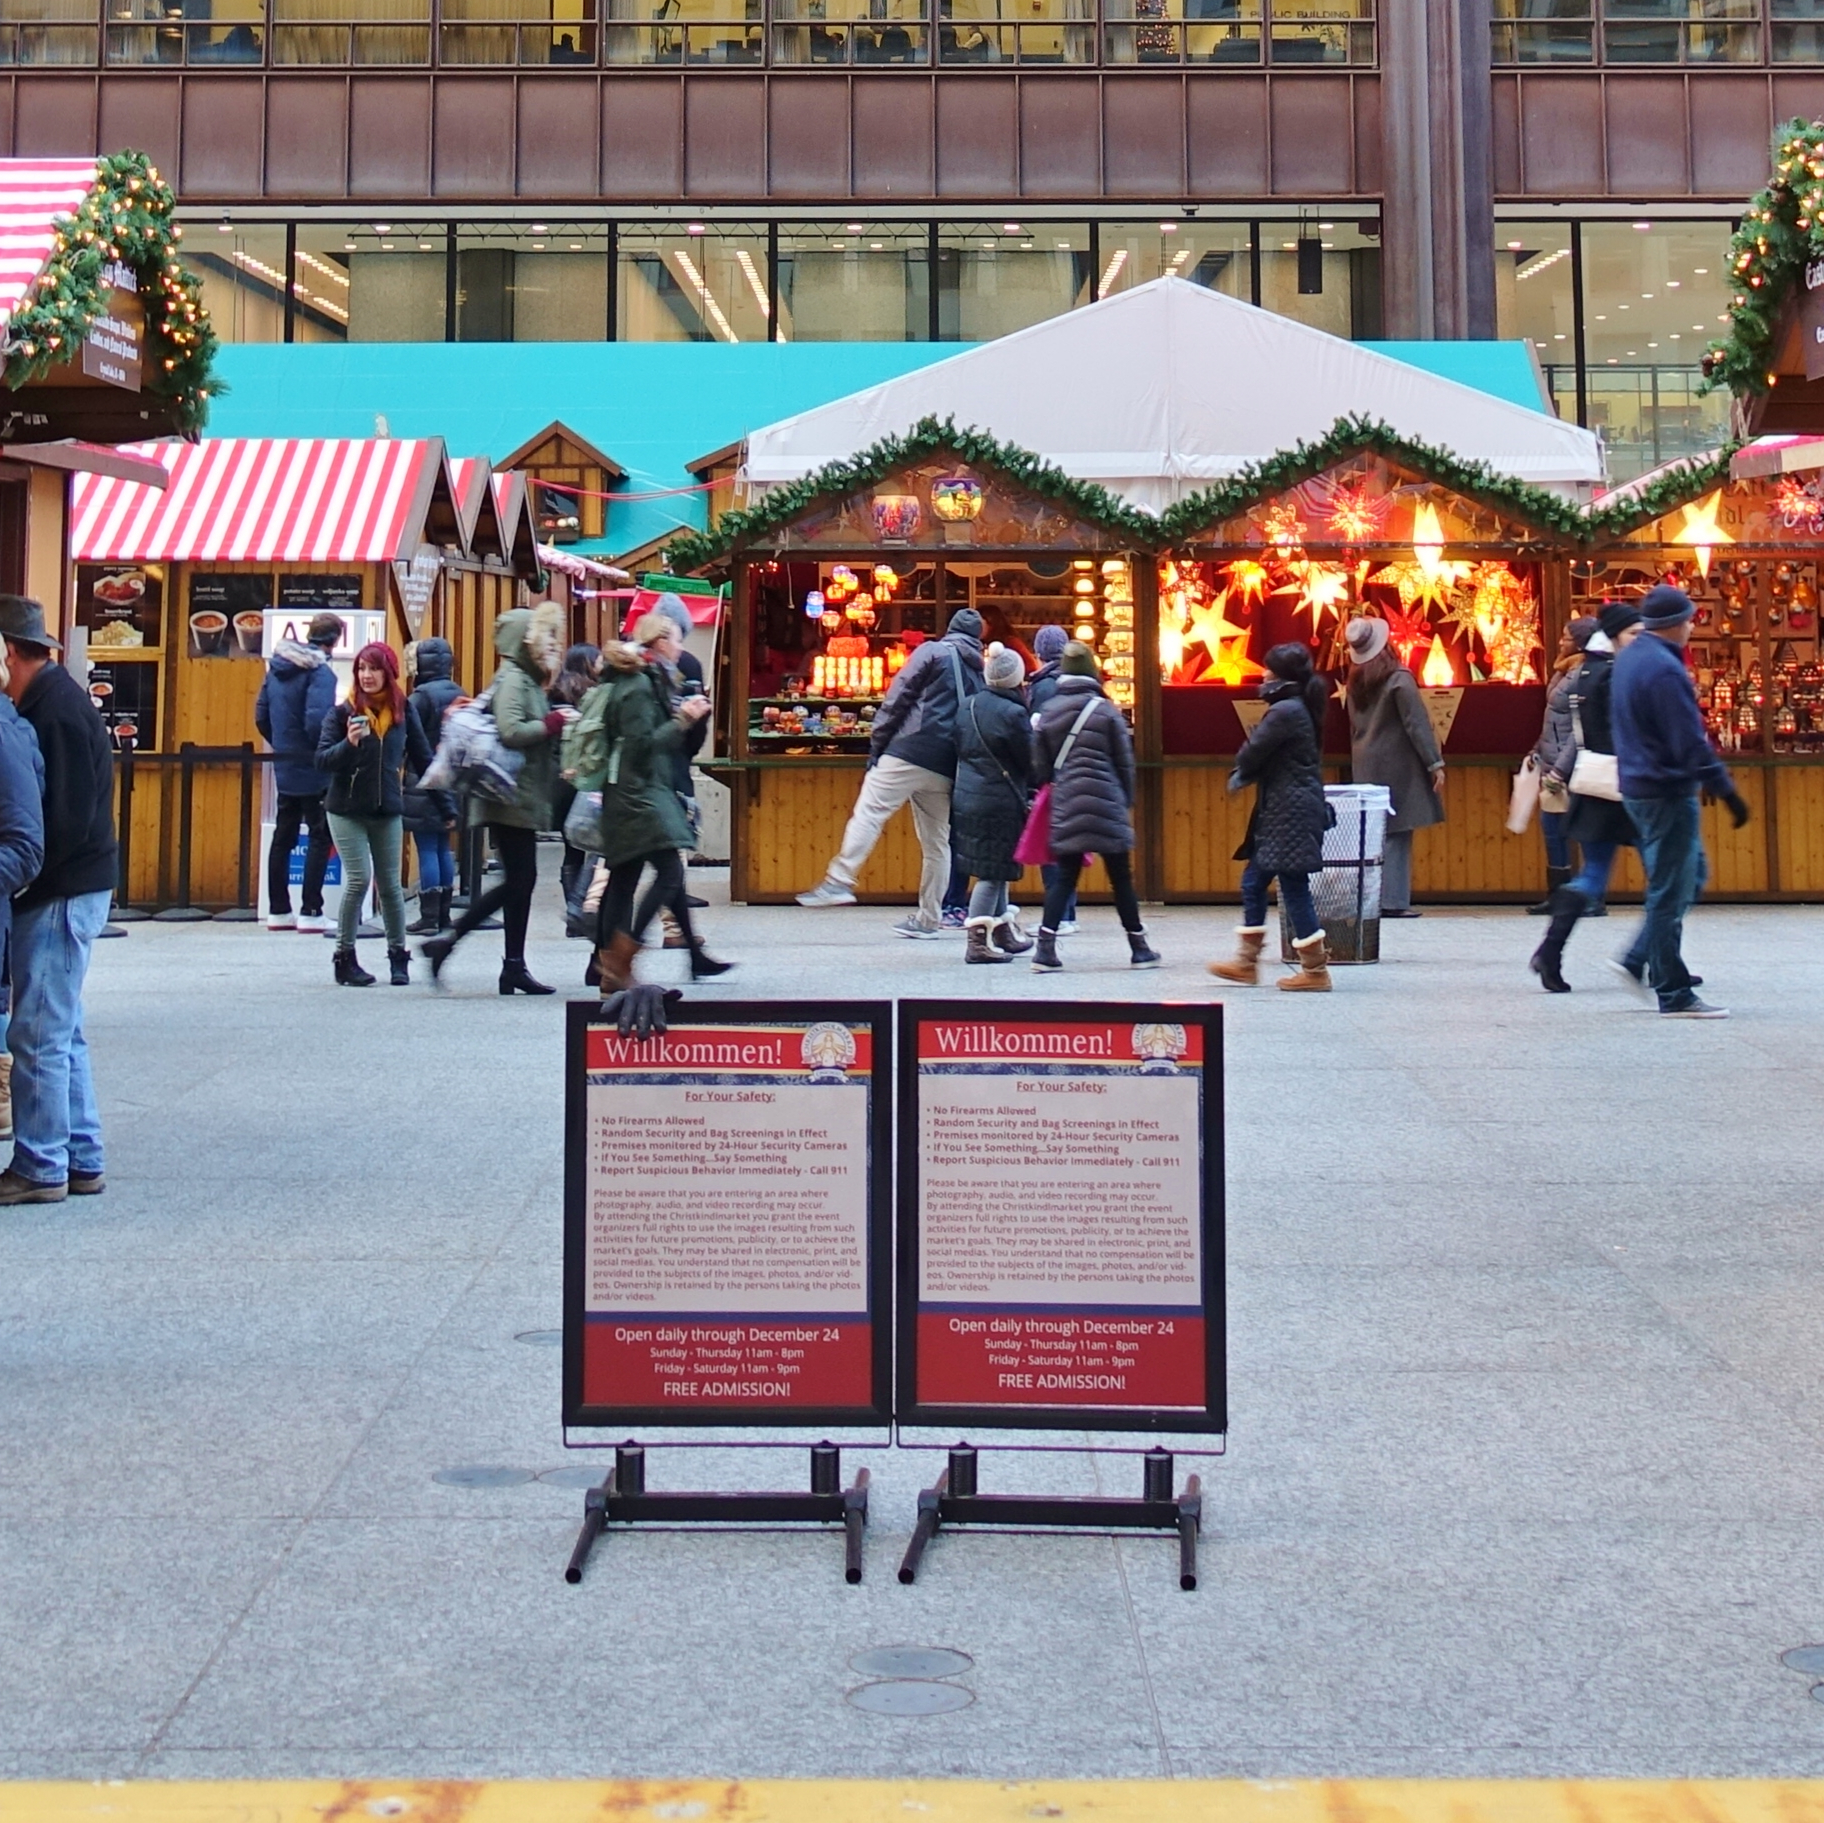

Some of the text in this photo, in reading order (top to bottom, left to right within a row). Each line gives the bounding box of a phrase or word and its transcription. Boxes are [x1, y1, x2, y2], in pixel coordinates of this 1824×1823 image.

[935, 1026, 1113, 1056] Willkommen!
[604, 1036, 782, 1065] Willkommen!
[1016, 1081, 1108, 1092] For Your Safety:
[684, 1091, 776, 1102] For Your Safety:
[933, 1105, 1036, 1116] No Firearms Allowed
[602, 1116, 705, 1126] No Firearms Allowed
[933, 1117, 975, 1128] Random
[976, 1118, 1018, 1130] Security
[1019, 1118, 1040, 1128] and
[1041, 1118, 1061, 1132] Bag
[1062, 1119, 1117, 1132] Screenings
[1130, 1119, 1160, 1130] Effect
[601, 1128, 644, 1138] Random
[644, 1128, 687, 1140] Security
[687, 1128, 708, 1138] and
[709, 1128, 729, 1140] Bag
[730, 1129, 785, 1140] Screenings
[798, 1128, 828, 1138] Effect
[932, 1130, 1181, 1145] Premises monitored by 24-Hour Security Cameras
[600, 1140, 848, 1153] Premises monitored by 24-Hour Security Cameras
[942, 1143, 963, 1152] You
[964, 1143, 983, 1153] See
[1065, 1144, 1121, 1157] Something
[610, 1153, 631, 1163] You
[631, 1153, 651, 1163] See
[733, 1153, 788, 1165] Something
[932, 1155, 967, 1167] Report
[969, 1155, 1022, 1166] Suspicious
[1023, 1156, 1069, 1166] Behavior
[1070, 1156, 1134, 1168] Immediately
[1141, 1156, 1162, 1167] Call
[1162, 1157, 1180, 1167] 911
[600, 1165, 635, 1177] Report
[636, 1165, 690, 1176] Suspicious
[691, 1165, 737, 1175] Behavior
[738, 1165, 803, 1177] Immediately
[809, 1165, 829, 1175] Call
[830, 1166, 848, 1175] 911
[594, 1188, 828, 1200] Please be aware that you are entering an area where
[948, 1318, 1175, 1337] Open daily through December 24
[614, 1327, 840, 1345] Open daily through December 24
[984, 1338, 1023, 1352] Sunday
[1029, 1338, 1078, 1353] Thursday
[1079, 1339, 1108, 1351] 11am
[1115, 1340, 1140, 1355] 8pm
[649, 1347, 688, 1361] Sunday
[694, 1347, 744, 1361] Thursday
[744, 1347, 774, 1358] 11am
[780, 1347, 805, 1360] 8pm
[988, 1353, 1020, 1368] Friday
[1027, 1354, 1074, 1369] Saturday
[1075, 1355, 1104, 1367] 11am
[1111, 1355, 1136, 1369] 9pm
[654, 1362, 686, 1376] Friday
[693, 1362, 739, 1376] Saturday
[741, 1362, 769, 1374] 11am
[776, 1363, 801, 1377] 9pm
[998, 1373, 1126, 1390] FREE ADMISSION!
[663, 1381, 791, 1397] FREE ADMISSION!
